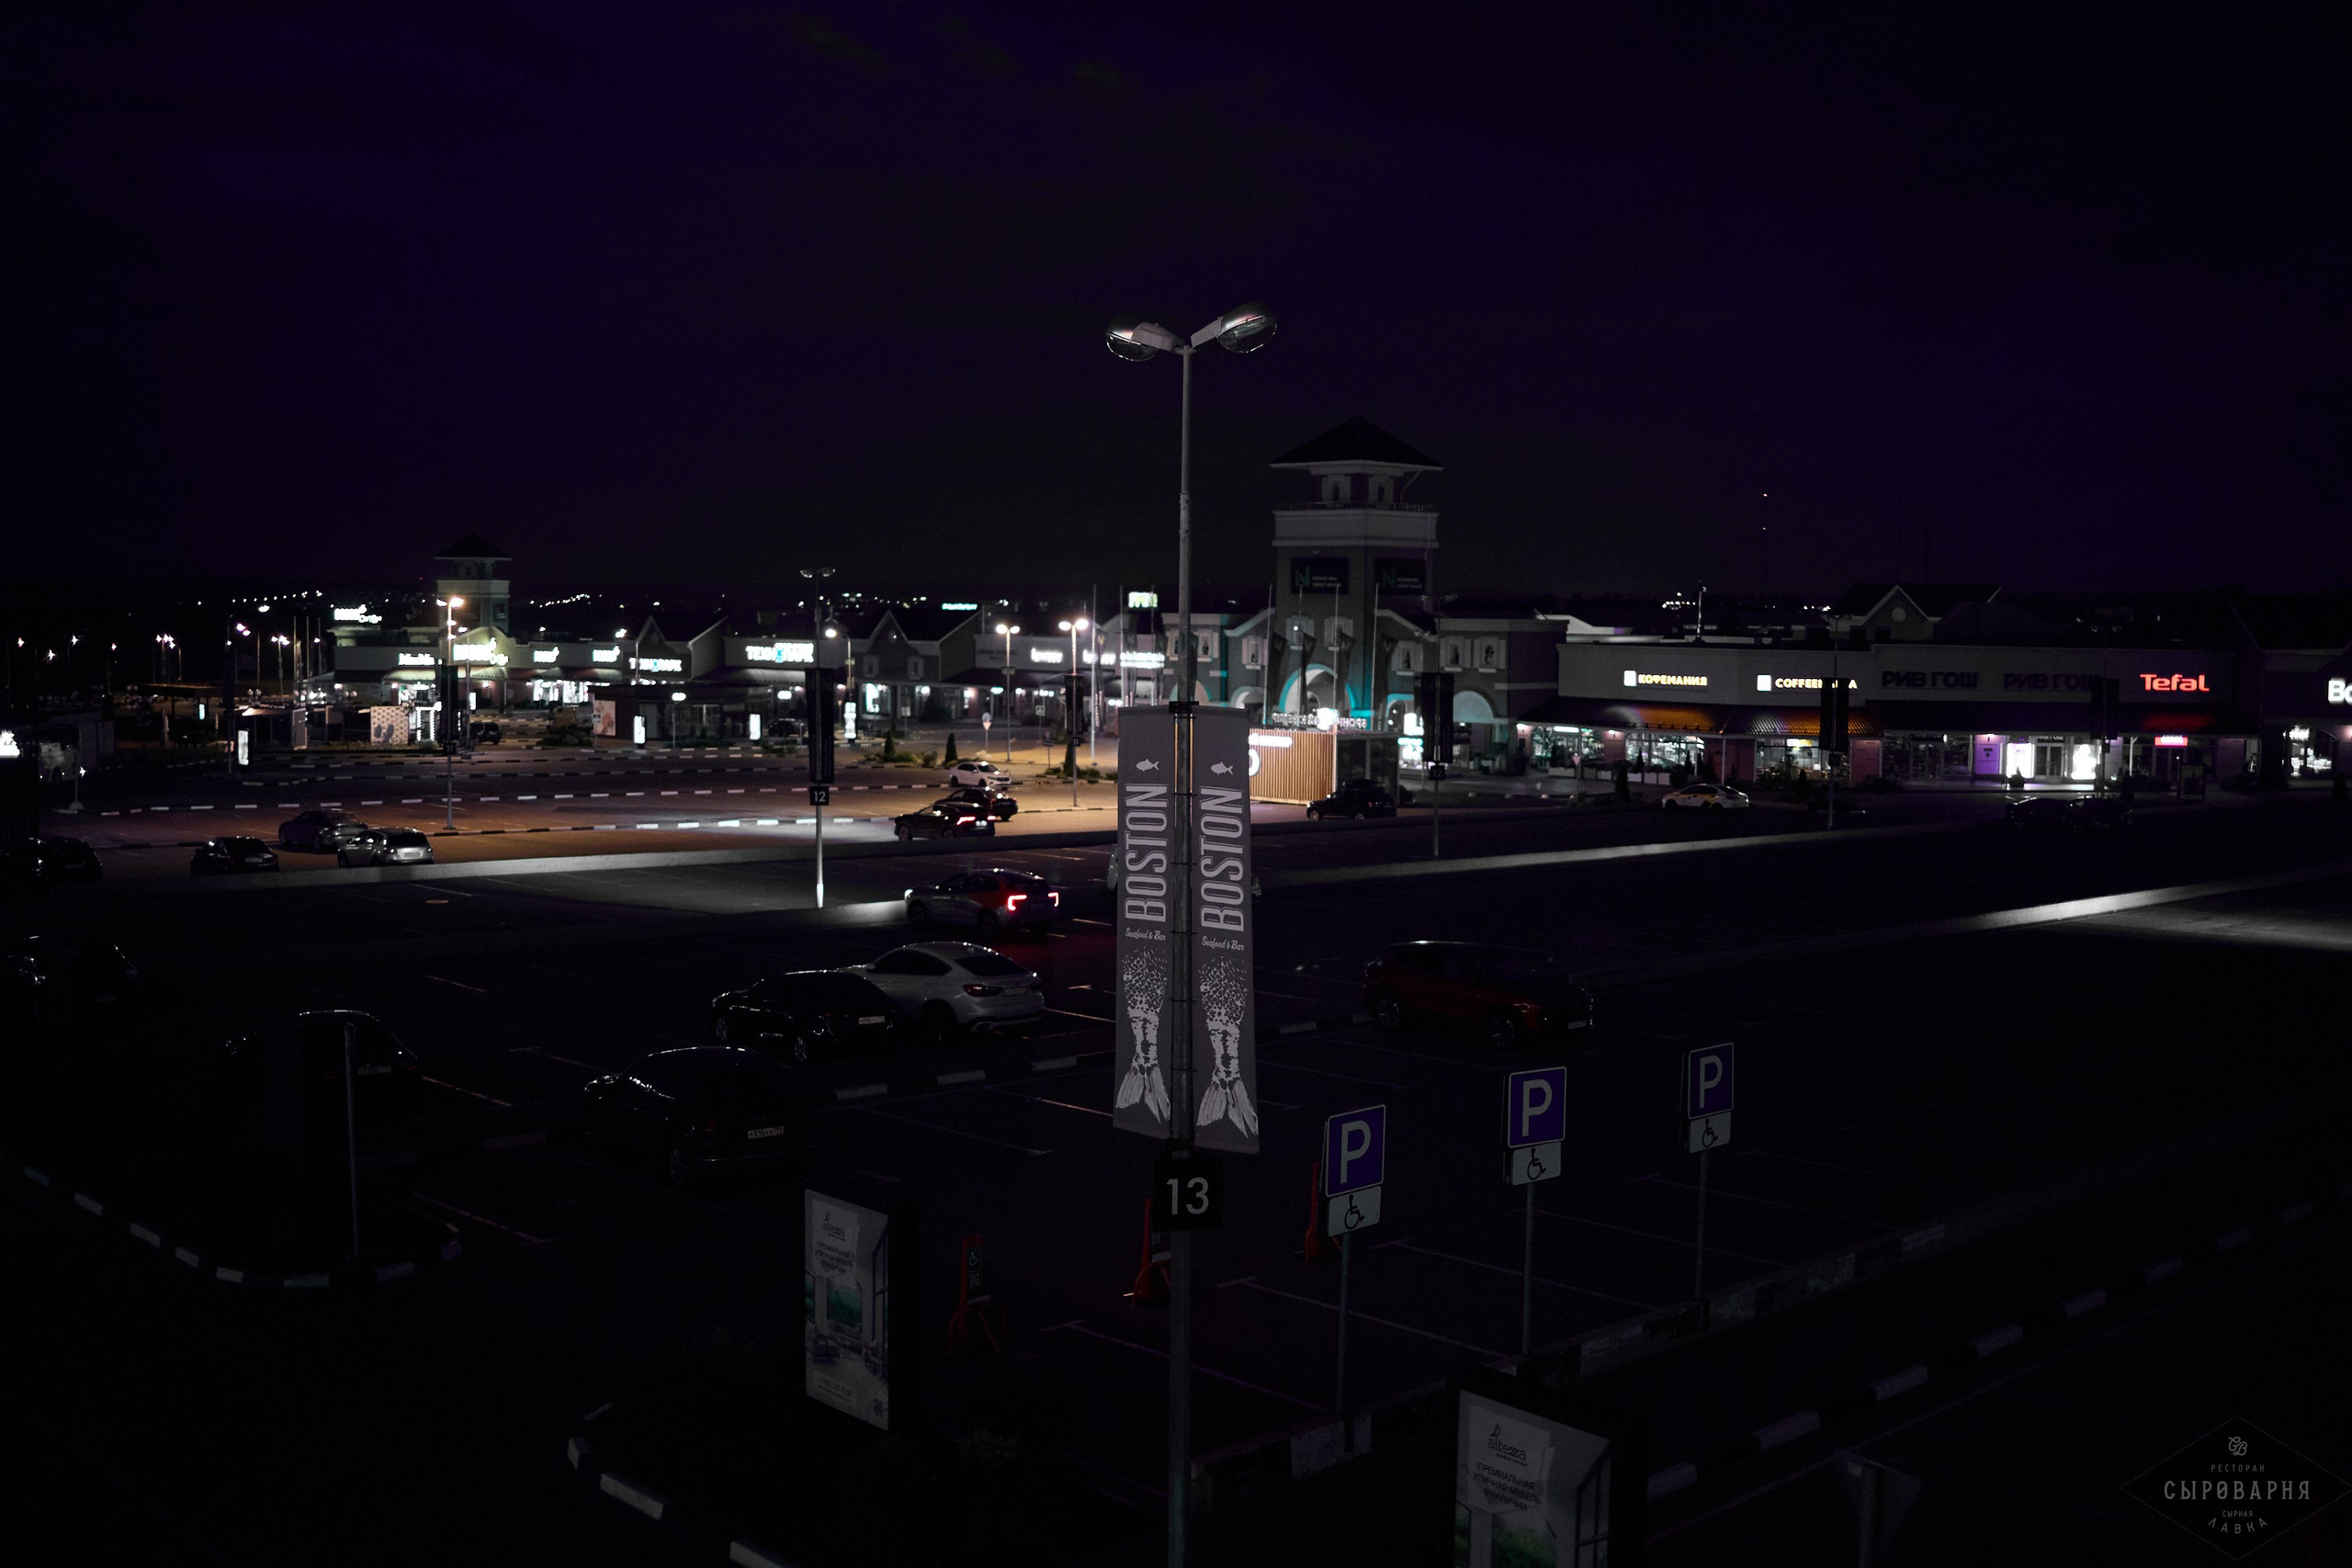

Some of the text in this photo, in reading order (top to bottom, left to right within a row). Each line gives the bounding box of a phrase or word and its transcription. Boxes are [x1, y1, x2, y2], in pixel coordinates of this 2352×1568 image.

[1638, 674, 1707, 686] КОФЕМАНИЯ
[1882, 671, 1978, 688] РИВ ГОШ
[2004, 673, 2047, 690] РИВ
[2140, 673, 2211, 693] Tefal
[813, 791, 826, 802] 12
[1125, 784, 1169, 922] BOSTON
[1199, 786, 1244, 931] BOSTON
[1125, 927, 1148, 941] Seafood
[1154, 930, 1166, 941] Bar
[1202, 935, 1227, 950] Seafood
[1231, 939, 1244, 951] Bar
[1700, 1055, 1724, 1109] P
[1521, 1078, 1554, 1138] P
[1339, 1119, 1373, 1186] P
[1166, 1177, 1210, 1215] 13
[1487, 1434, 1526, 1461] altezza
[1473, 1472, 1542, 1506] УЛИЧНАЯ МЕБЕЛЬ
[1478, 1462, 1535, 1490] ПРЕМИАЛЬНАЯ
